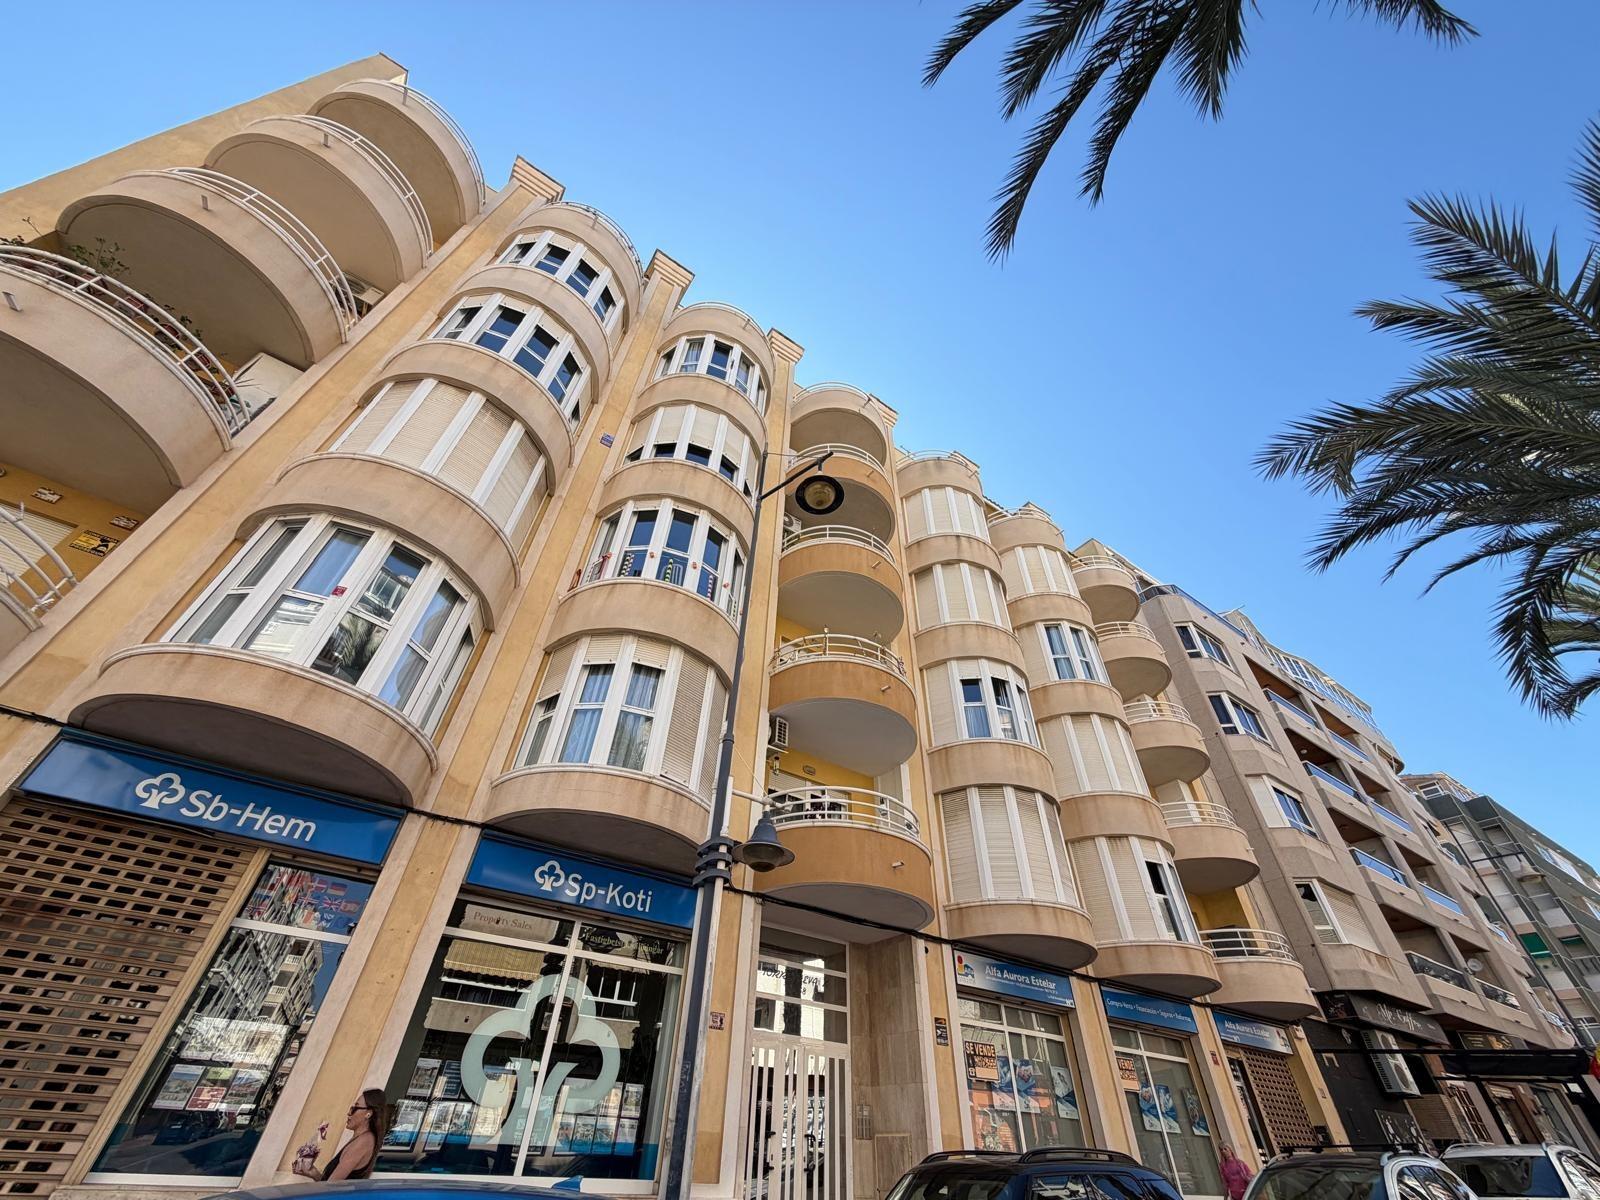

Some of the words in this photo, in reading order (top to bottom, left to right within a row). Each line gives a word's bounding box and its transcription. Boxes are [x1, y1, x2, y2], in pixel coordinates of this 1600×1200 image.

[180, 789, 317, 842] Sb-Hem
[565, 873, 653, 913] Sp-Koti
[985, 965, 1002, 978] Alfa
[1003, 969, 1030, 984] Aurora
[1031, 975, 1057, 990] Estelar
[965, 1042, 975, 1054] SE
[974, 1043, 996, 1057] VENDE
